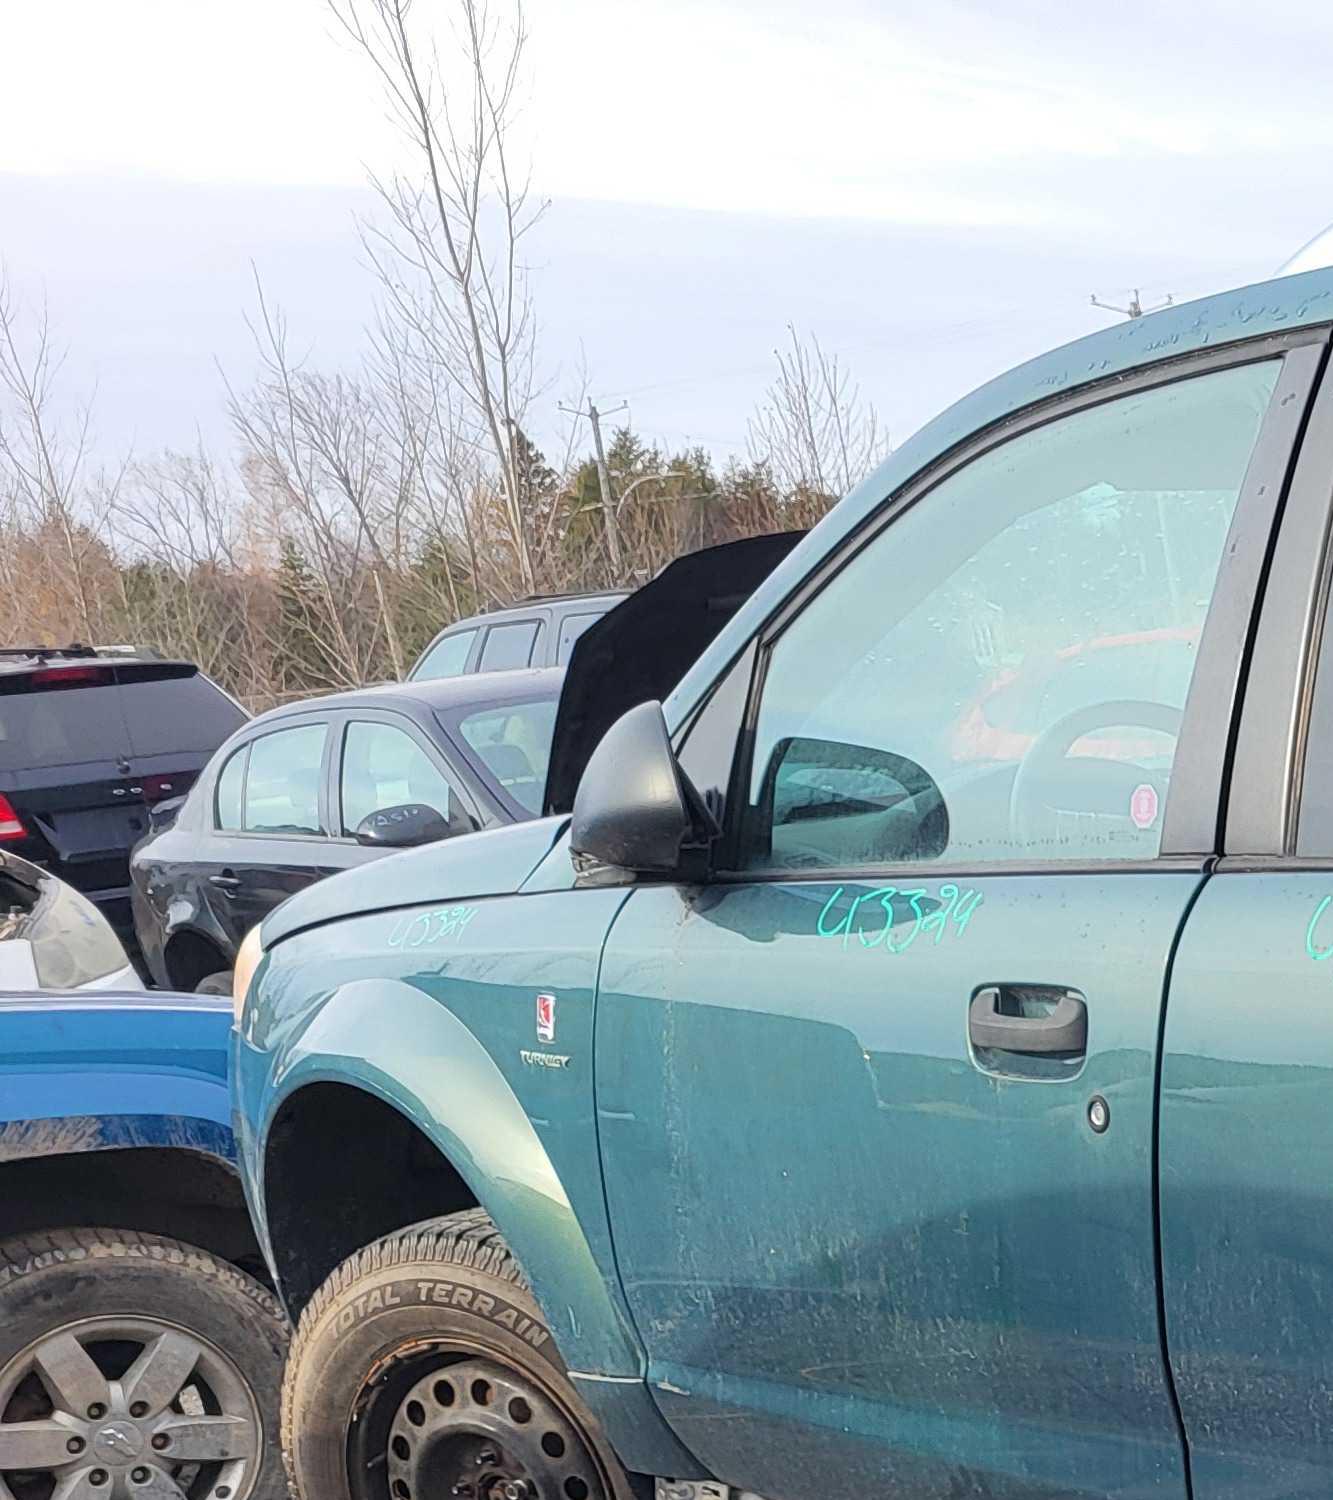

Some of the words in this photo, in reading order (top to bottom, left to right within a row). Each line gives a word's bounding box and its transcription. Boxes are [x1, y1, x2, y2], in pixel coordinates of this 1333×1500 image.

[818, 884, 983, 953] 43324
[330, 1285, 401, 1340] TOTAL
[416, 1281, 550, 1349] TERRAIN
